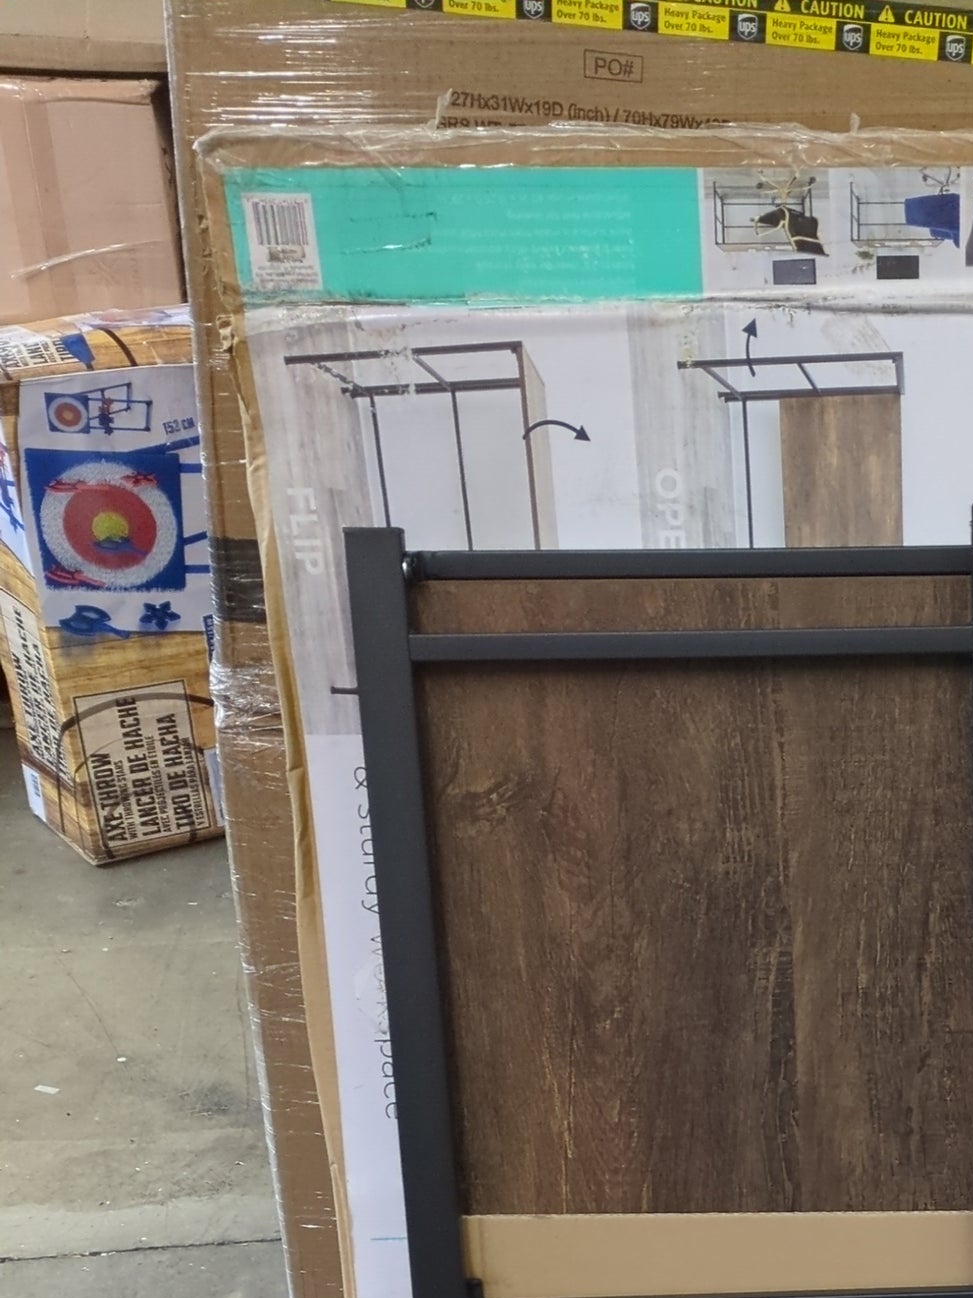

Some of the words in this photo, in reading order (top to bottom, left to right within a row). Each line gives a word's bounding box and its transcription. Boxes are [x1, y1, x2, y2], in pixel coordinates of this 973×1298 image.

[472, 1, 482, 11] 70
[556, 0, 584, 9] Heavy
[585, 1, 619, 12] Package
[664, 8, 689, 20] Heavy
[692, 10, 726, 23] Package
[801, 0, 864, 19] CAUTION
[556, 10, 576, 19] Over
[578, 11, 590, 20] 70
[592, 12, 607, 23] lbs.
[772, 18, 797, 31] Heavy
[800, 20, 833, 34] Package
[904, 10, 967, 30] CAUTION
[664, 21, 683, 30] Over
[686, 22, 696, 32] 70
[699, 23, 713, 33] lbs.
[876, 29, 900, 41] Heavy
[903, 32, 936, 44] Package
[772, 32, 790, 41] Over
[793, 33, 804, 42] 70
[876, 43, 894, 52] Over
[896, 44, 907, 53] 70
[909, 45, 923, 54] lbs.
[594, 58, 634, 77] PO#
[451, 91, 563, 117] 27Hx31Wx19D
[568, 103, 609, 122] (inch)
[622, 109, 731, 129] 70Hx79Wx
[286, 487, 325, 575] FLIP
[116, 697, 144, 750] HACHE
[156, 713, 183, 767] HACHA
[114, 760, 127, 782] STARS
[128, 754, 149, 773] DE
[90, 752, 121, 810] THROW
[168, 770, 187, 790] DE
[131, 777, 161, 836] LANCER
[188, 783, 204, 819] ESTRELLAS
[172, 794, 195, 830] TIRO
[101, 813, 128, 842] AXE
[125, 822, 138, 839] WITH
[159, 815, 172, 832] AVEC
